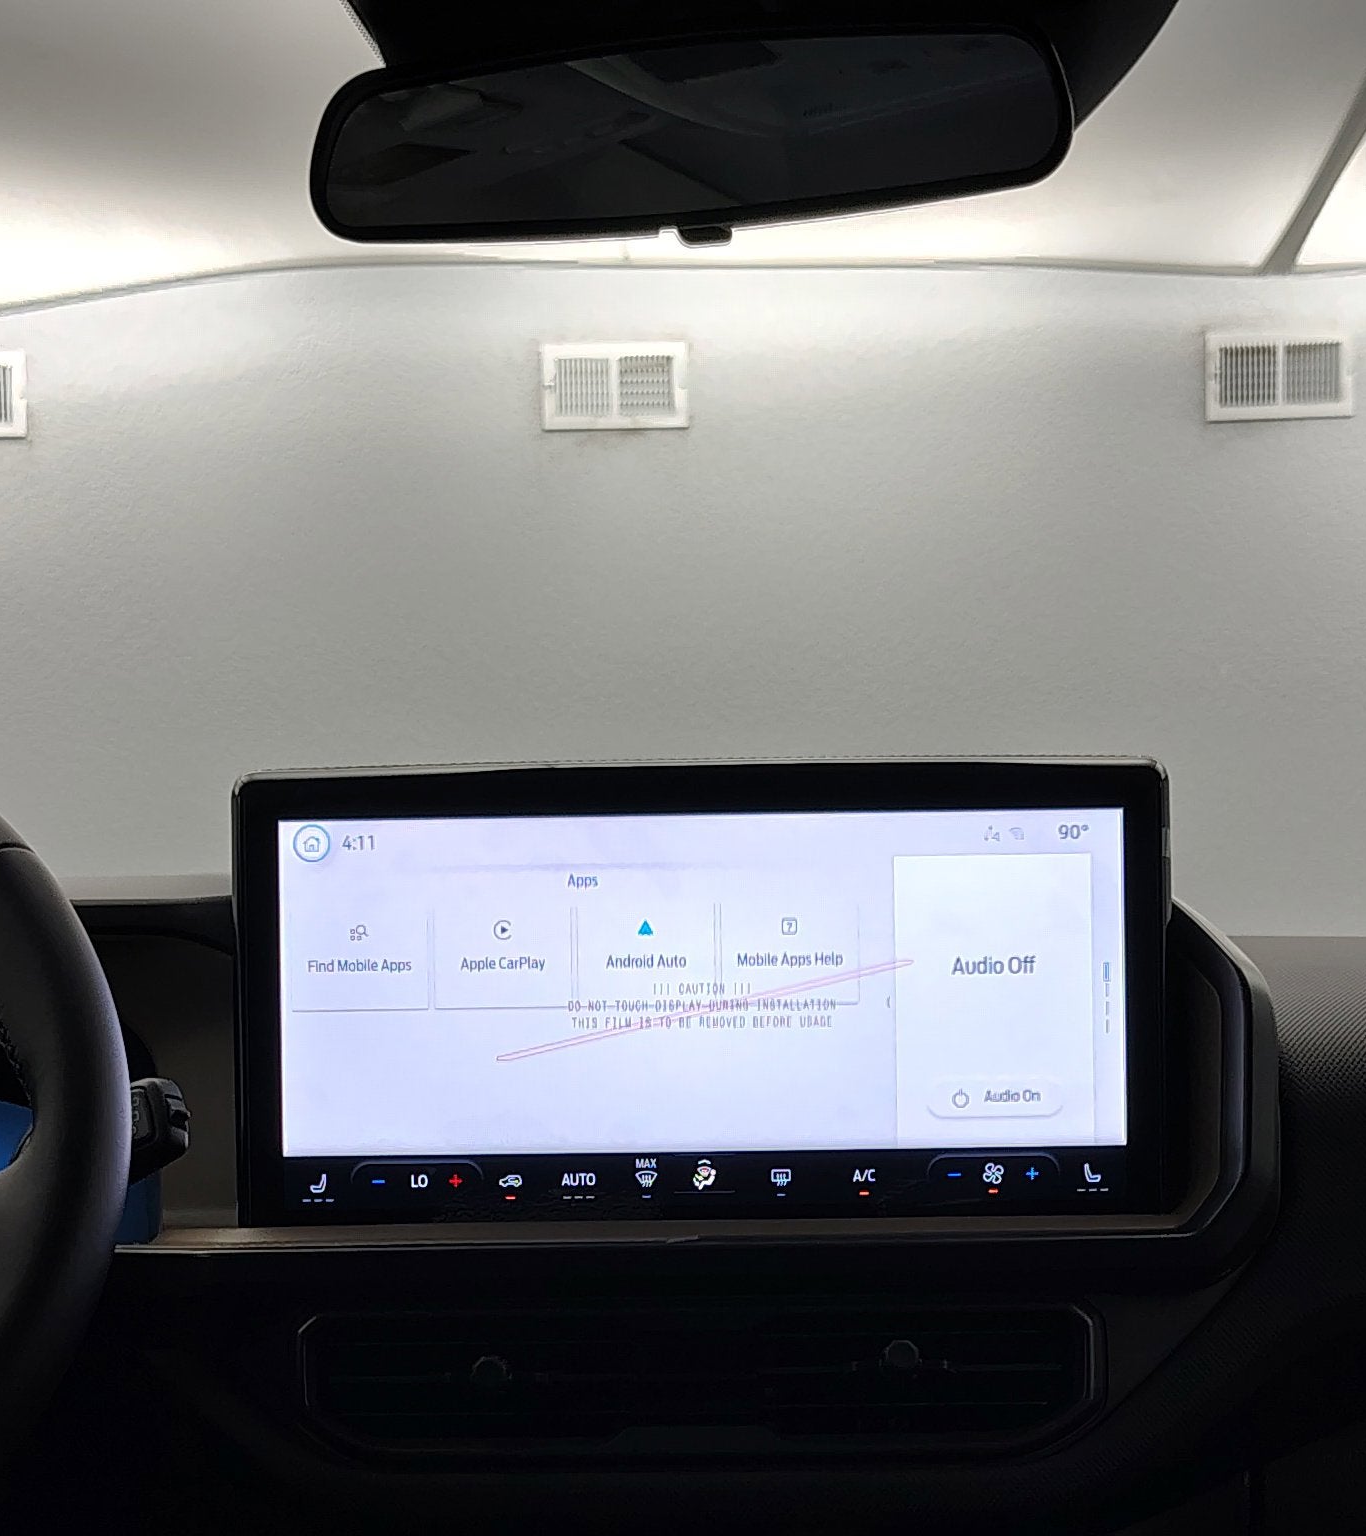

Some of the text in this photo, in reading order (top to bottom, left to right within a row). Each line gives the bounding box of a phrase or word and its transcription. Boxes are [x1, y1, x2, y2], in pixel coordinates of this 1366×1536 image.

[342, 835, 375, 850] 4:11
[567, 873, 599, 888] Apps
[308, 959, 412, 973] Find Mobile Apps
[460, 957, 545, 972] Apple CarPlay
[606, 954, 687, 969] Android Auto
[737, 952, 843, 968] Mobile Apps Help
[951, 955, 1037, 976] Audio Off
[678, 982, 725, 996] CAUTION
[568, 1000, 581, 1012] DO
[587, 1000, 607, 1012] NOT
[615, 1000, 649, 1012] TOUCH
[655, 999, 701, 1012] DISPLAY
[757, 998, 837, 1012] INSTALLATION
[572, 1017, 598, 1029] THIS
[605, 1016, 632, 1030] FILM
[640, 1016, 653, 1030] IS
[660, 1016, 671, 1028] TO
[983, 1089, 1041, 1103] Audio On
[635, 1158, 657, 1169] MAX
[410, 1174, 429, 1188] LO
[561, 1172, 597, 1187] AUTO
[853, 1168, 876, 1184] A/C
